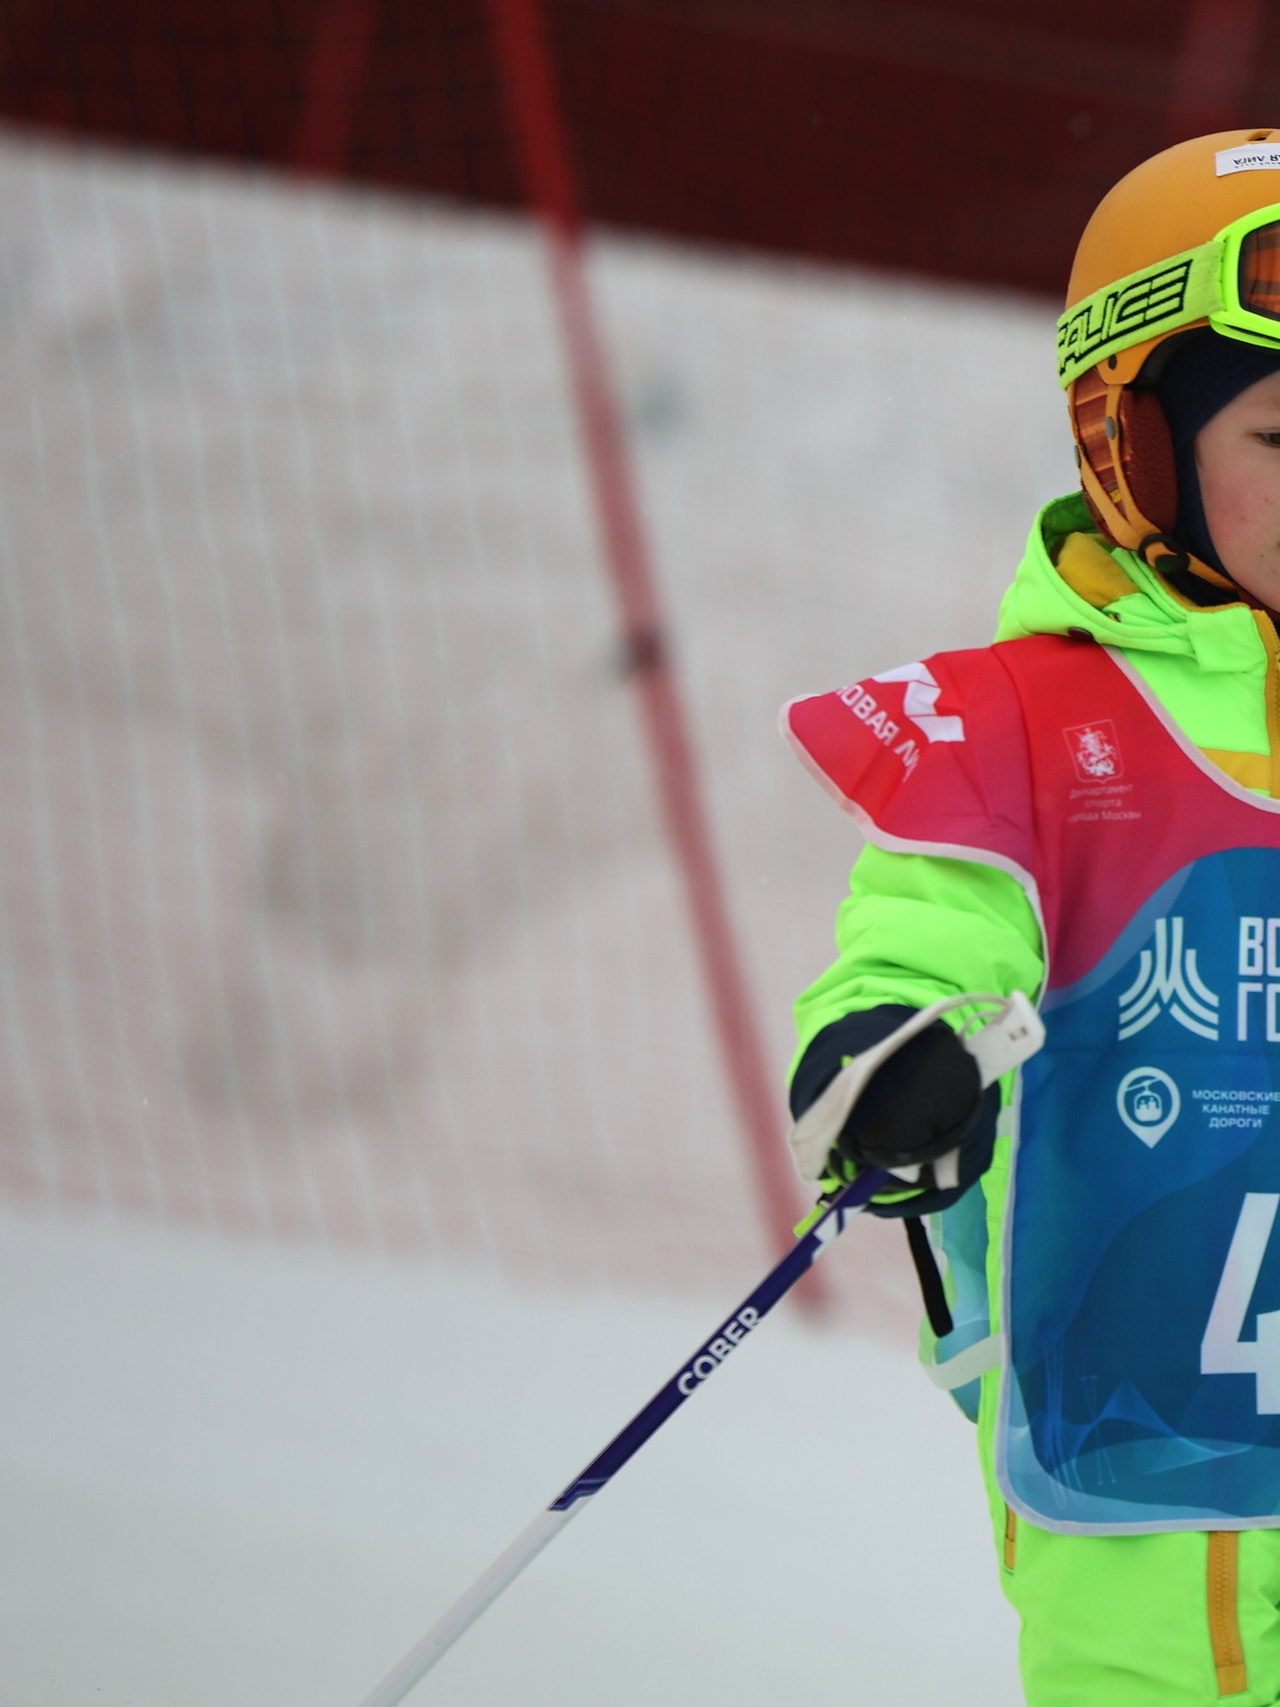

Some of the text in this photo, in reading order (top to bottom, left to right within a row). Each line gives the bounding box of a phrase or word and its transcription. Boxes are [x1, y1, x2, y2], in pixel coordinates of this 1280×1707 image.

[836, 684, 900, 746] ОВАЯ
[1192, 1089, 1280, 1102] МОСКОВСКИЕ
[1202, 1103, 1270, 1115] КАНАТНЫЕ
[1208, 1116, 1263, 1129] ДОРОГИ
[677, 1306, 760, 1396] COBER
